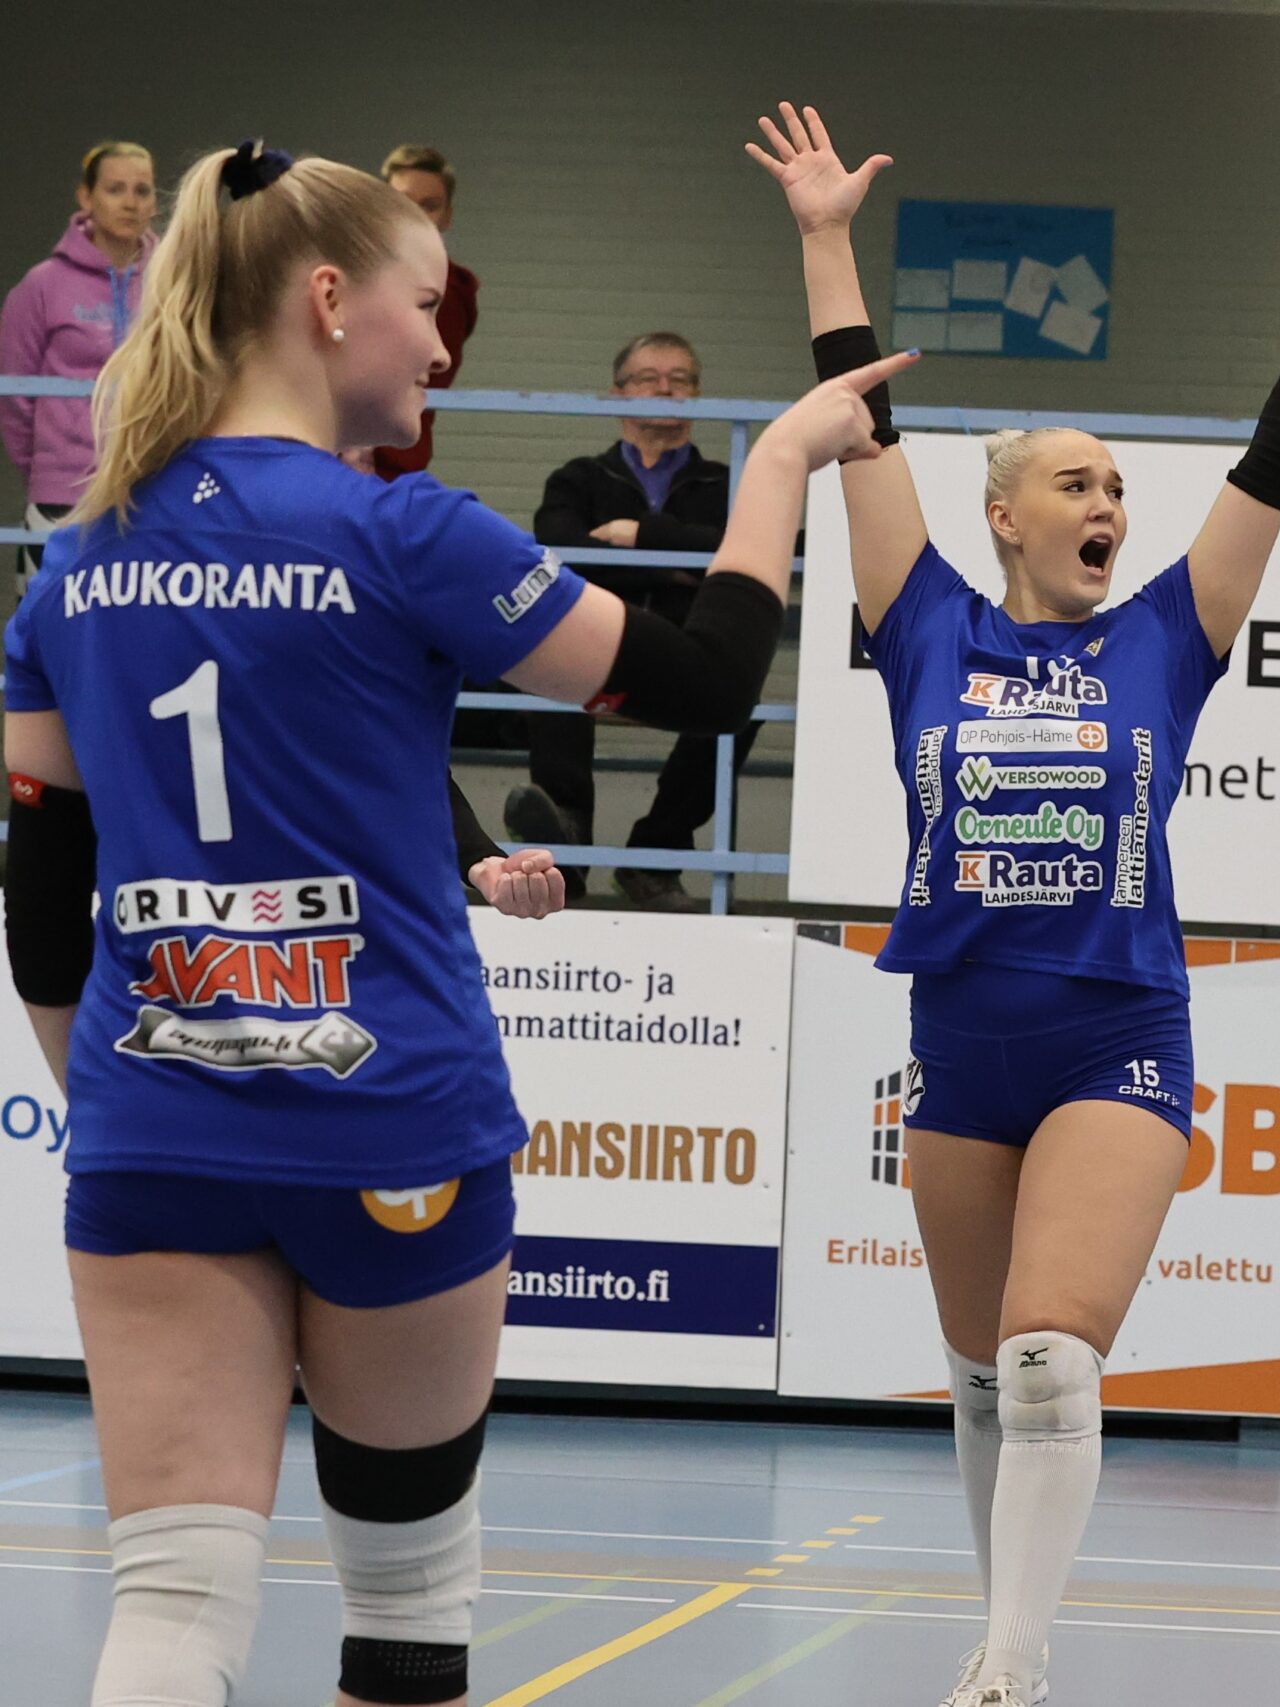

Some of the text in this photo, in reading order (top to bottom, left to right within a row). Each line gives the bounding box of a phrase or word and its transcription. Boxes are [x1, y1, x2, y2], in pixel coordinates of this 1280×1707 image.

[64, 560, 357, 618] KAUKORANTA
[1000, 668, 1104, 707] Ruta
[149, 660, 232, 842] 1
[960, 728, 1073, 747] OP Pohjois-Häme
[996, 771, 1102, 784] VERSOWOOD
[1066, 809, 1101, 847] Oy
[1126, 729, 1151, 907] lattiamestarit
[988, 854, 1101, 888] Rauta
[1112, 815, 1133, 905] tampereen
[985, 889, 1072, 904] LAHDESJÄRVI
[644, 965, 675, 1003] ja
[1124, 1059, 1160, 1087] 15
[1118, 1085, 1171, 1102] CRAFT
[511, 1119, 757, 1185] ANSIIRTO
[827, 1238, 924, 1268] Erilais
[1157, 1253, 1273, 1284] valettu
[506, 1265, 671, 1302] ansiirto.fi
